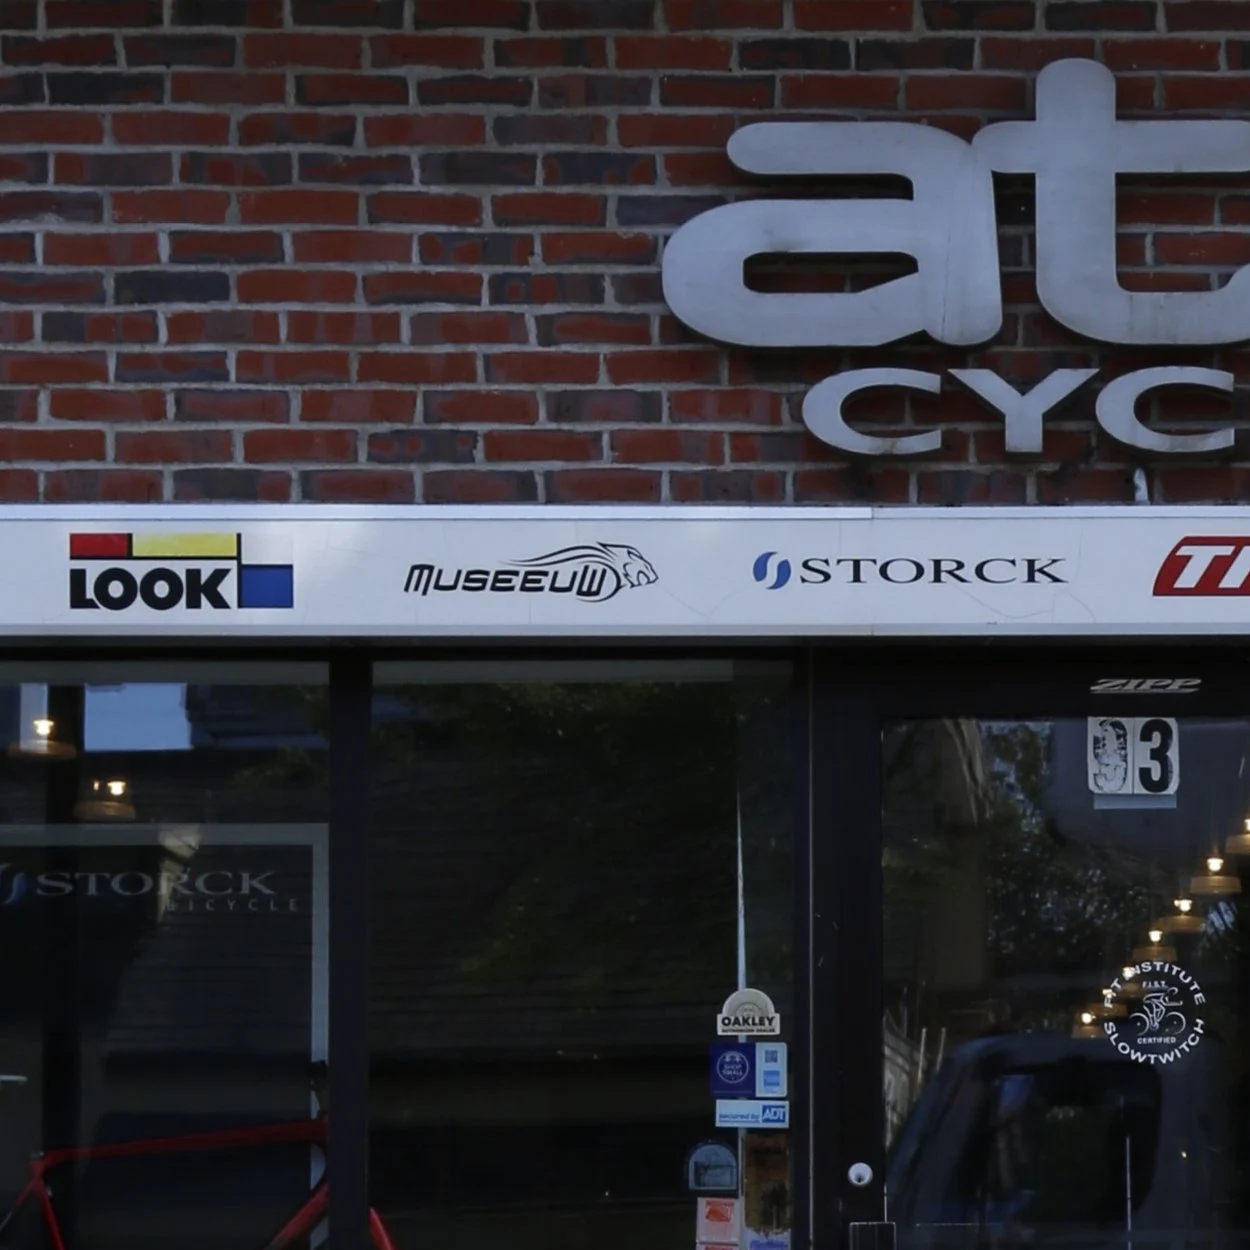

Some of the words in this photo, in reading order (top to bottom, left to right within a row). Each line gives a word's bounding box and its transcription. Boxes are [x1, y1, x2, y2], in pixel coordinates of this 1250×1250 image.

[800, 557, 1068, 584] STORCK
[69, 566, 232, 610] LOOK
[36, 870, 278, 897] STORCK
[721, 1016, 776, 1027] OAKLEY
[1104, 1018, 1205, 1065] SLOWTWITCH
[1137, 1036, 1177, 1045] CERTIFIED
[763, 1107, 785, 1120] ADT
